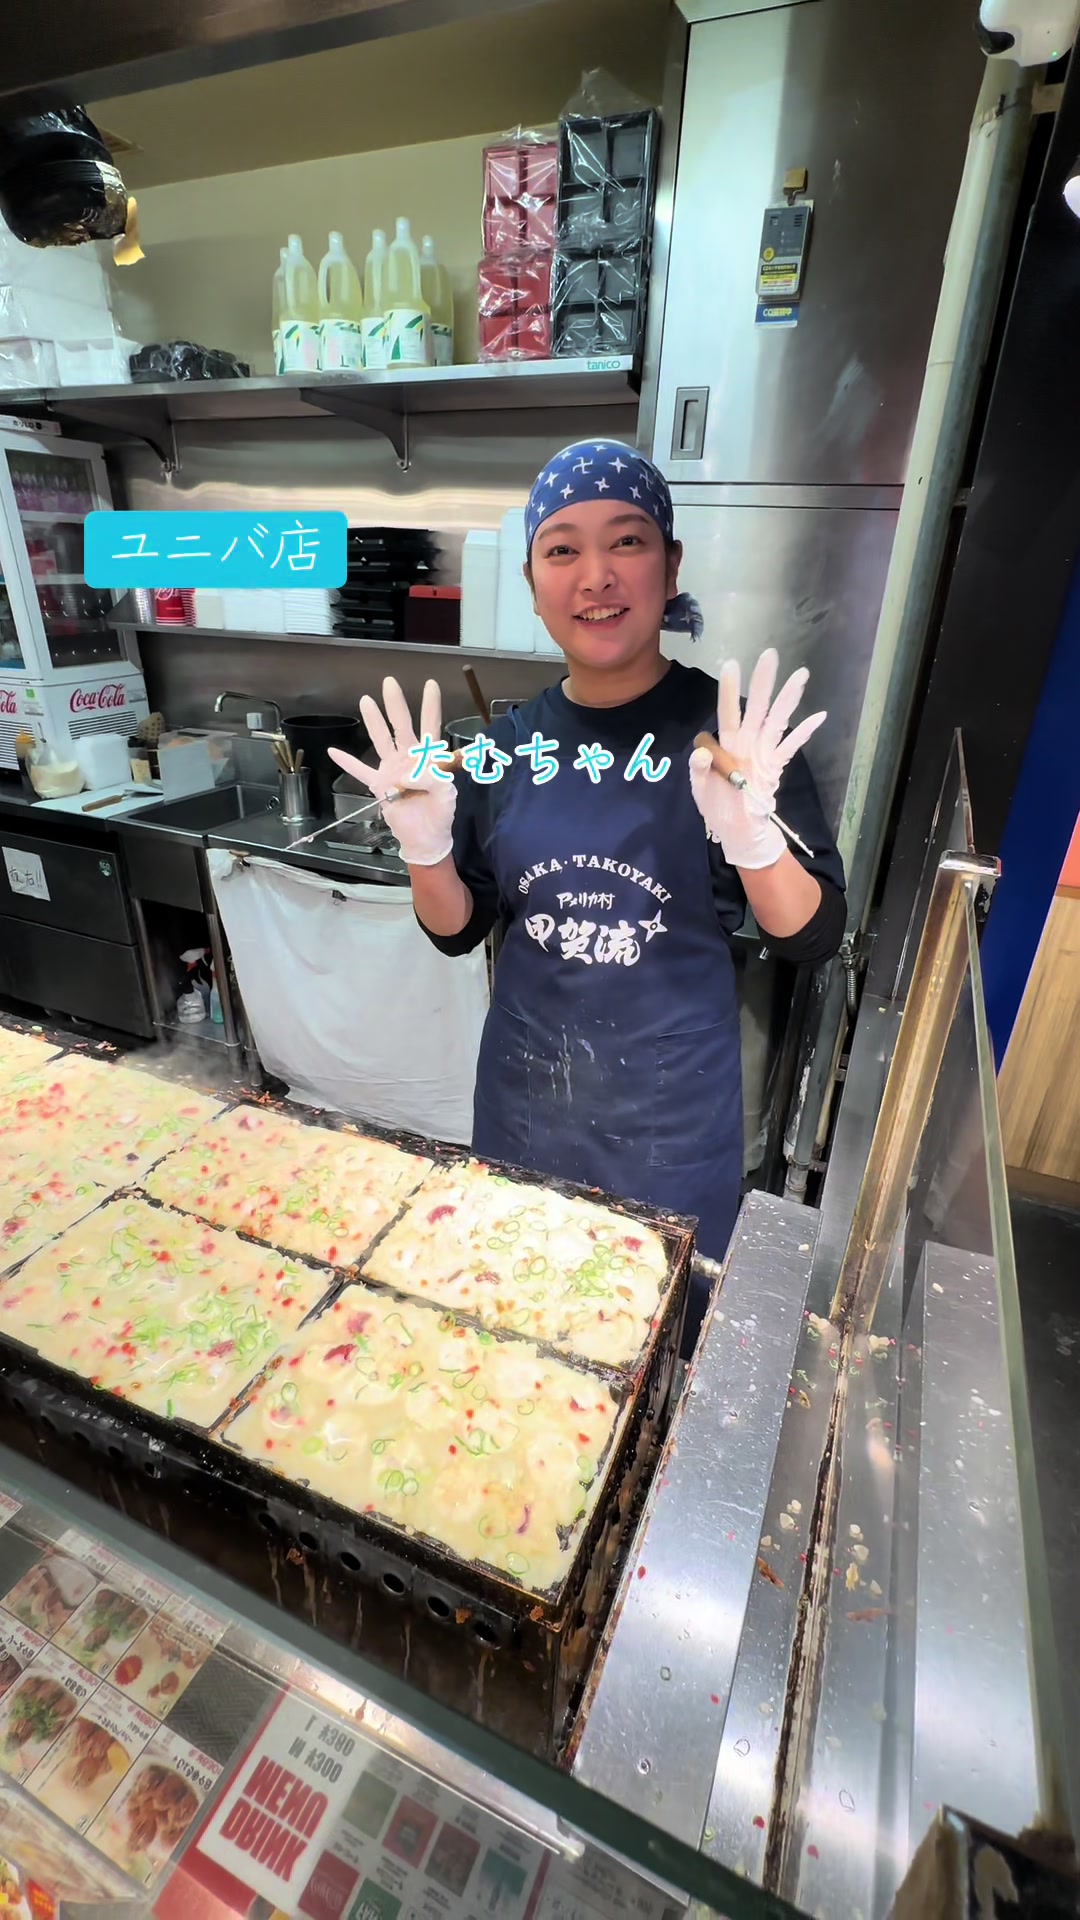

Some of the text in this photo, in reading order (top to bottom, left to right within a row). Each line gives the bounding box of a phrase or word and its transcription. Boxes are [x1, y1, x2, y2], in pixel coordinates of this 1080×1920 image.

[586, 358, 621, 370] tanico
[572, 854, 672, 904] TAKOYAKI
[556, 892, 615, 910] アメリカ村
[525, 913, 641, 967] 甲賀流
